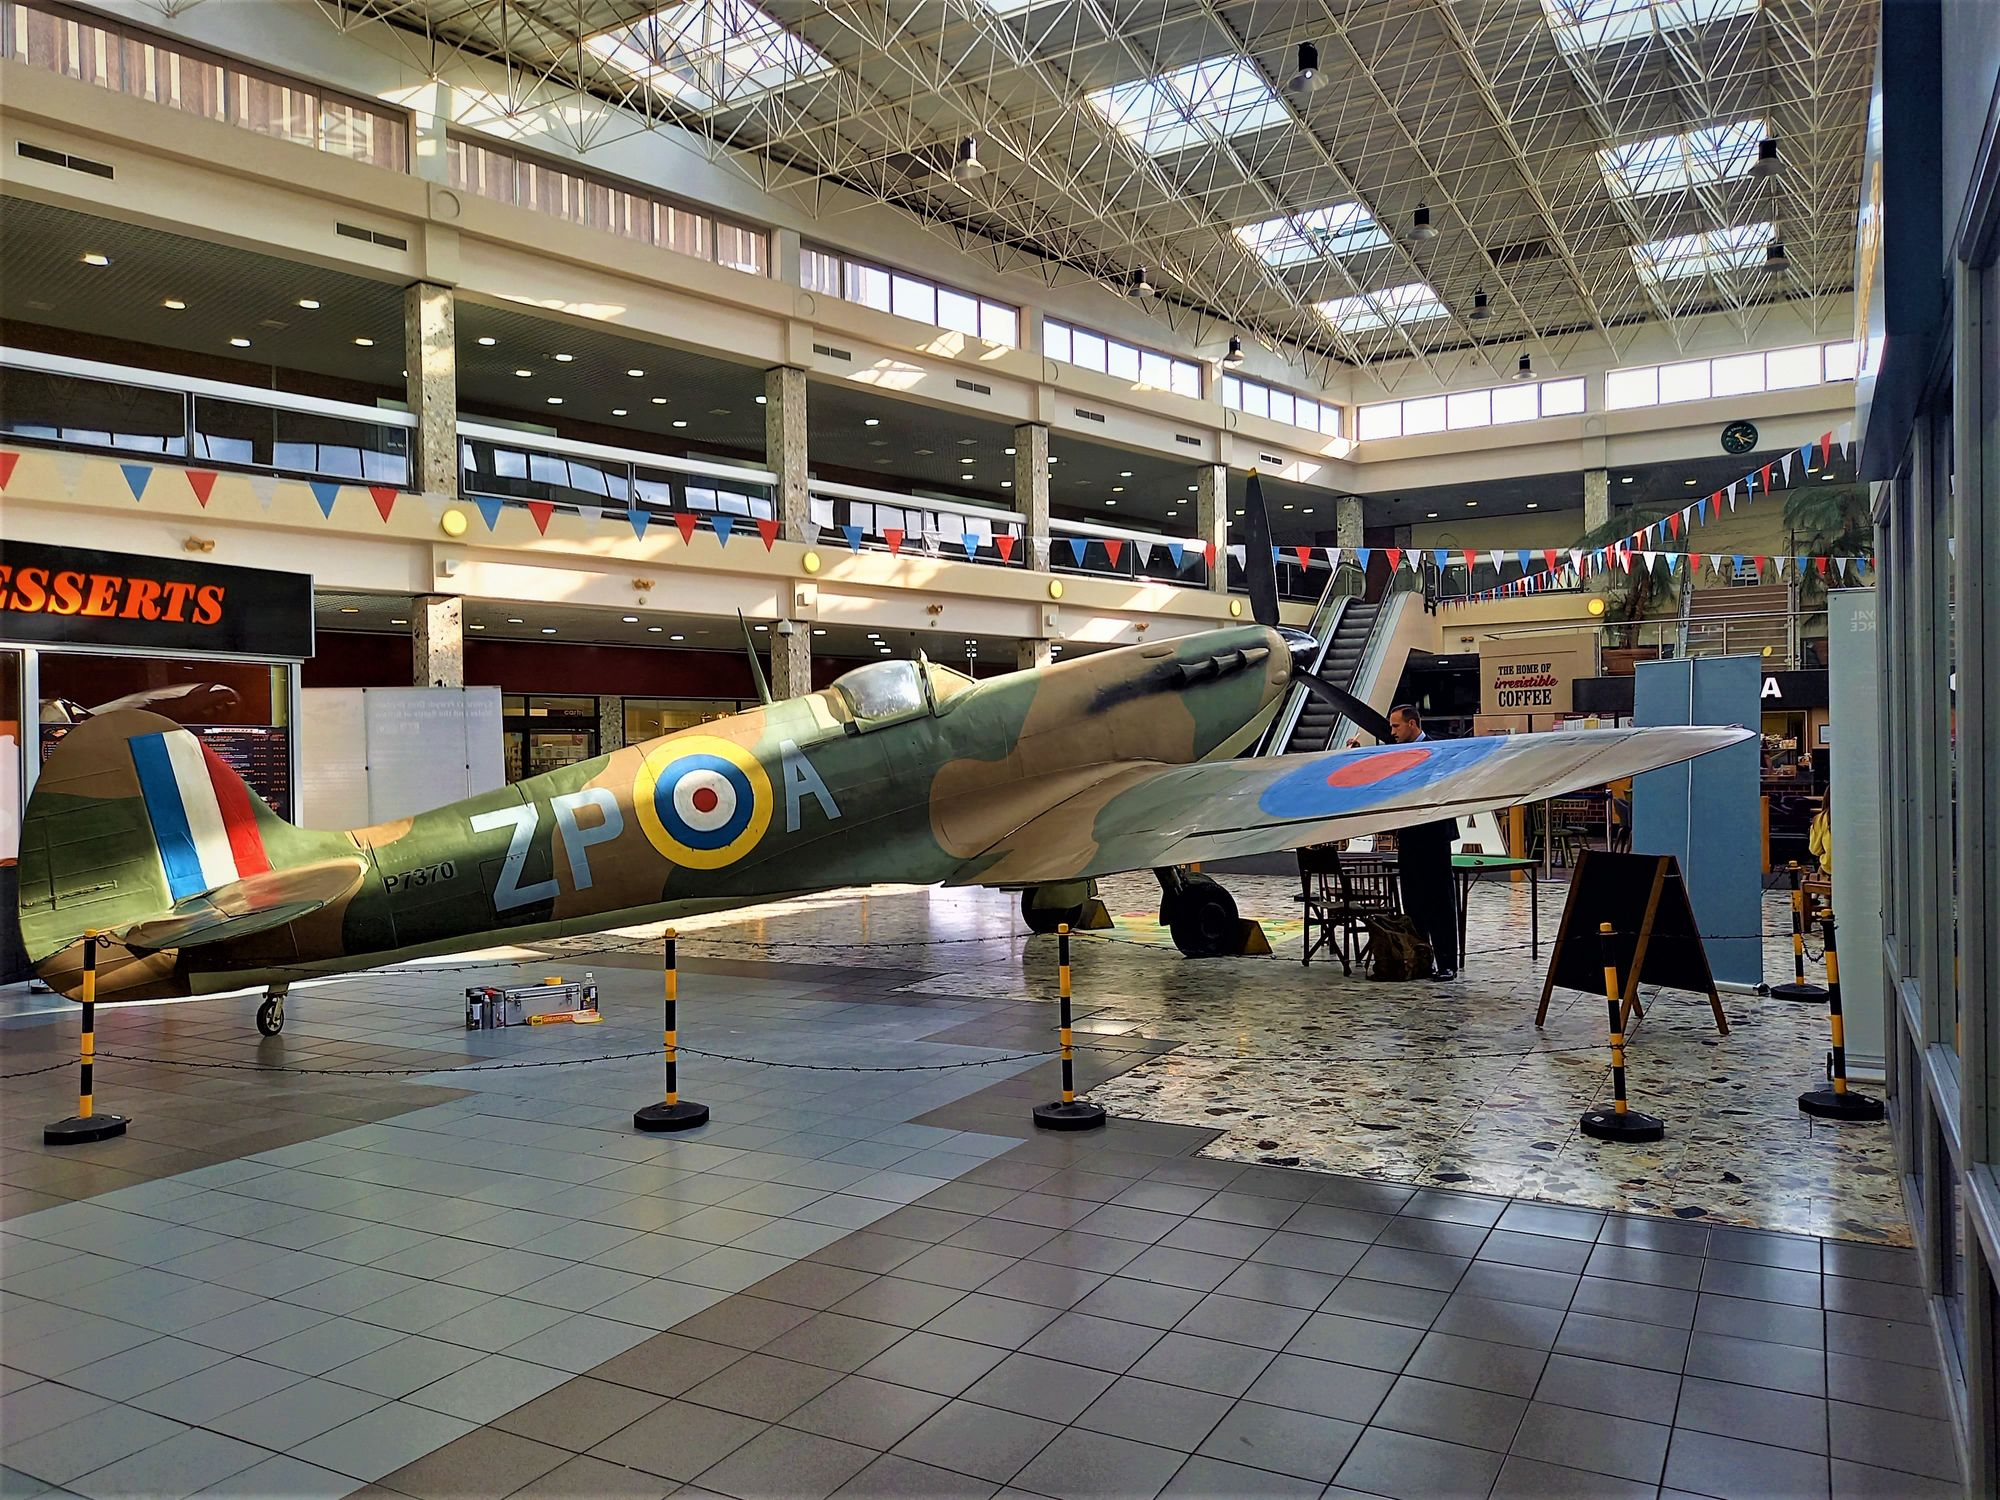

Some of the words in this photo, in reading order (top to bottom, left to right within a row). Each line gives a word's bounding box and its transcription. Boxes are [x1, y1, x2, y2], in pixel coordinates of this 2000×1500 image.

[1498, 665, 1514, 675] THE
[1516, 664, 1538, 674] HOME
[1541, 663, 1552, 672] OF
[1494, 674, 1557, 689] irresistible
[1498, 689, 1552, 707] COFFEE
[779, 738, 842, 833] A
[382, 861, 455, 895] P7370
